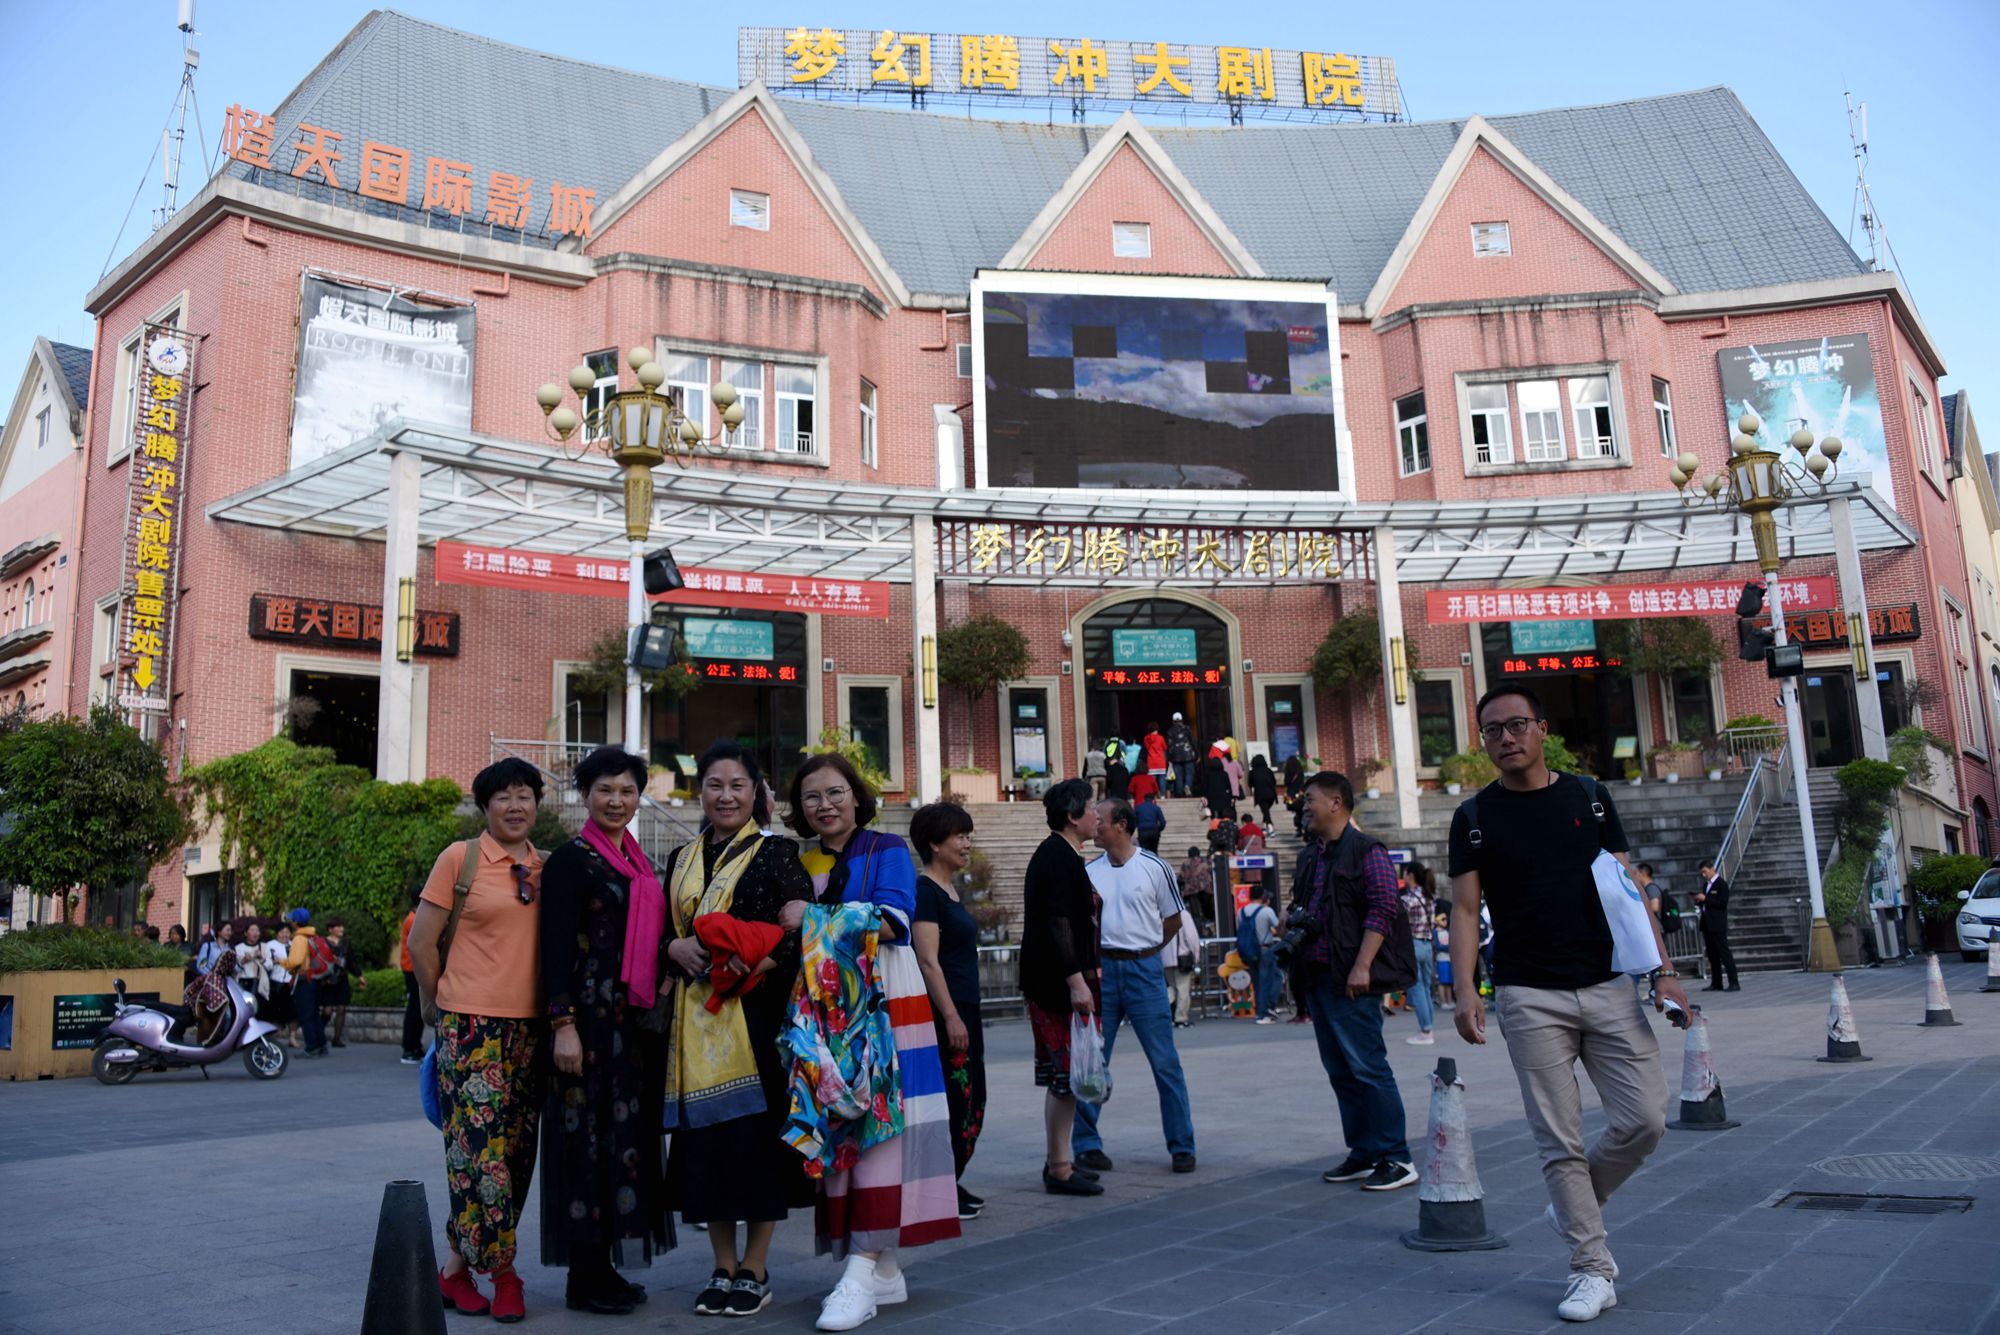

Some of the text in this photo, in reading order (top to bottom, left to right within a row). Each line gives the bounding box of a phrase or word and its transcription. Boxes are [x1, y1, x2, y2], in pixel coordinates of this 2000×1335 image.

[785, 27, 1365, 107] 梦幻腾冲大剧院
[223, 103, 597, 239] 橙天国际影城
[319, 295, 459, 343] 橙天国际影城
[314, 329, 462, 374] ROGUE ONE
[1749, 352, 1844, 381] 梦幻腾冲
[130, 374, 183, 656] 梦幻腾冲大剧院售票处
[969, 523, 1342, 577] 梦幻腾冲大剧院
[265, 598, 450, 648] 橙天国际城
[1448, 582, 1818, 617] 开展扫黑除恶专项斗争，创造安全稳定的环境。
[1753, 607, 1913, 643] 天国际影城
[1103, 669, 1220, 684] 平等、公正、法治、爱
